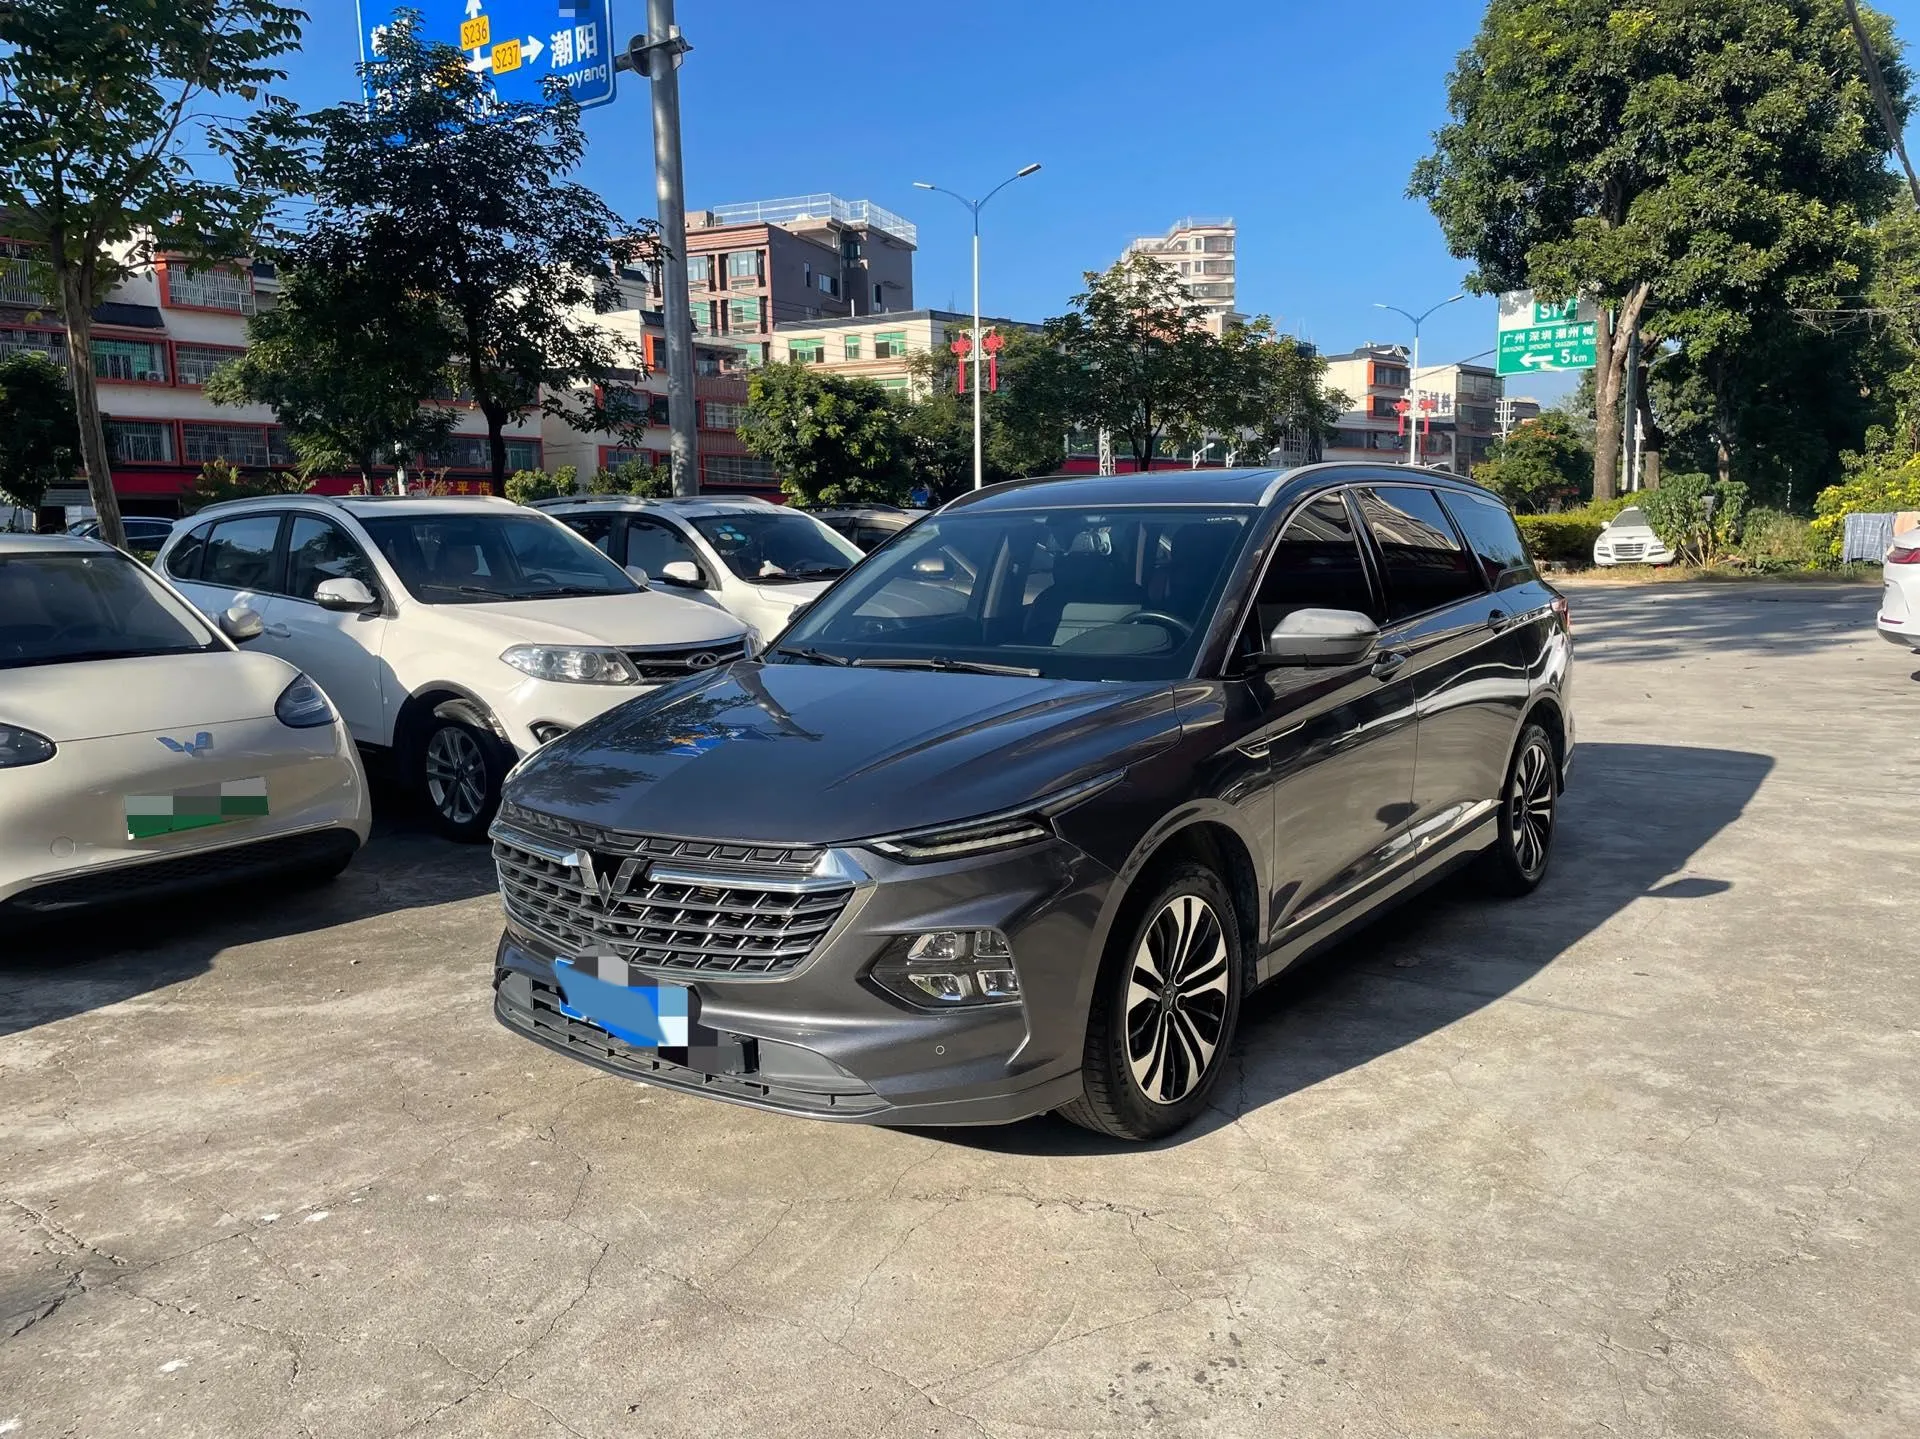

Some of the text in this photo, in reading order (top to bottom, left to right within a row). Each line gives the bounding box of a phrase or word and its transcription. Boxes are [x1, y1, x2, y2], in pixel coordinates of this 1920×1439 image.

[463, 20, 488, 46] S236
[550, 22, 598, 68] 潮阳
[495, 44, 519, 68] S237
[561, 64, 607, 89] oyang
[1561, 349, 1587, 364] 5 km
